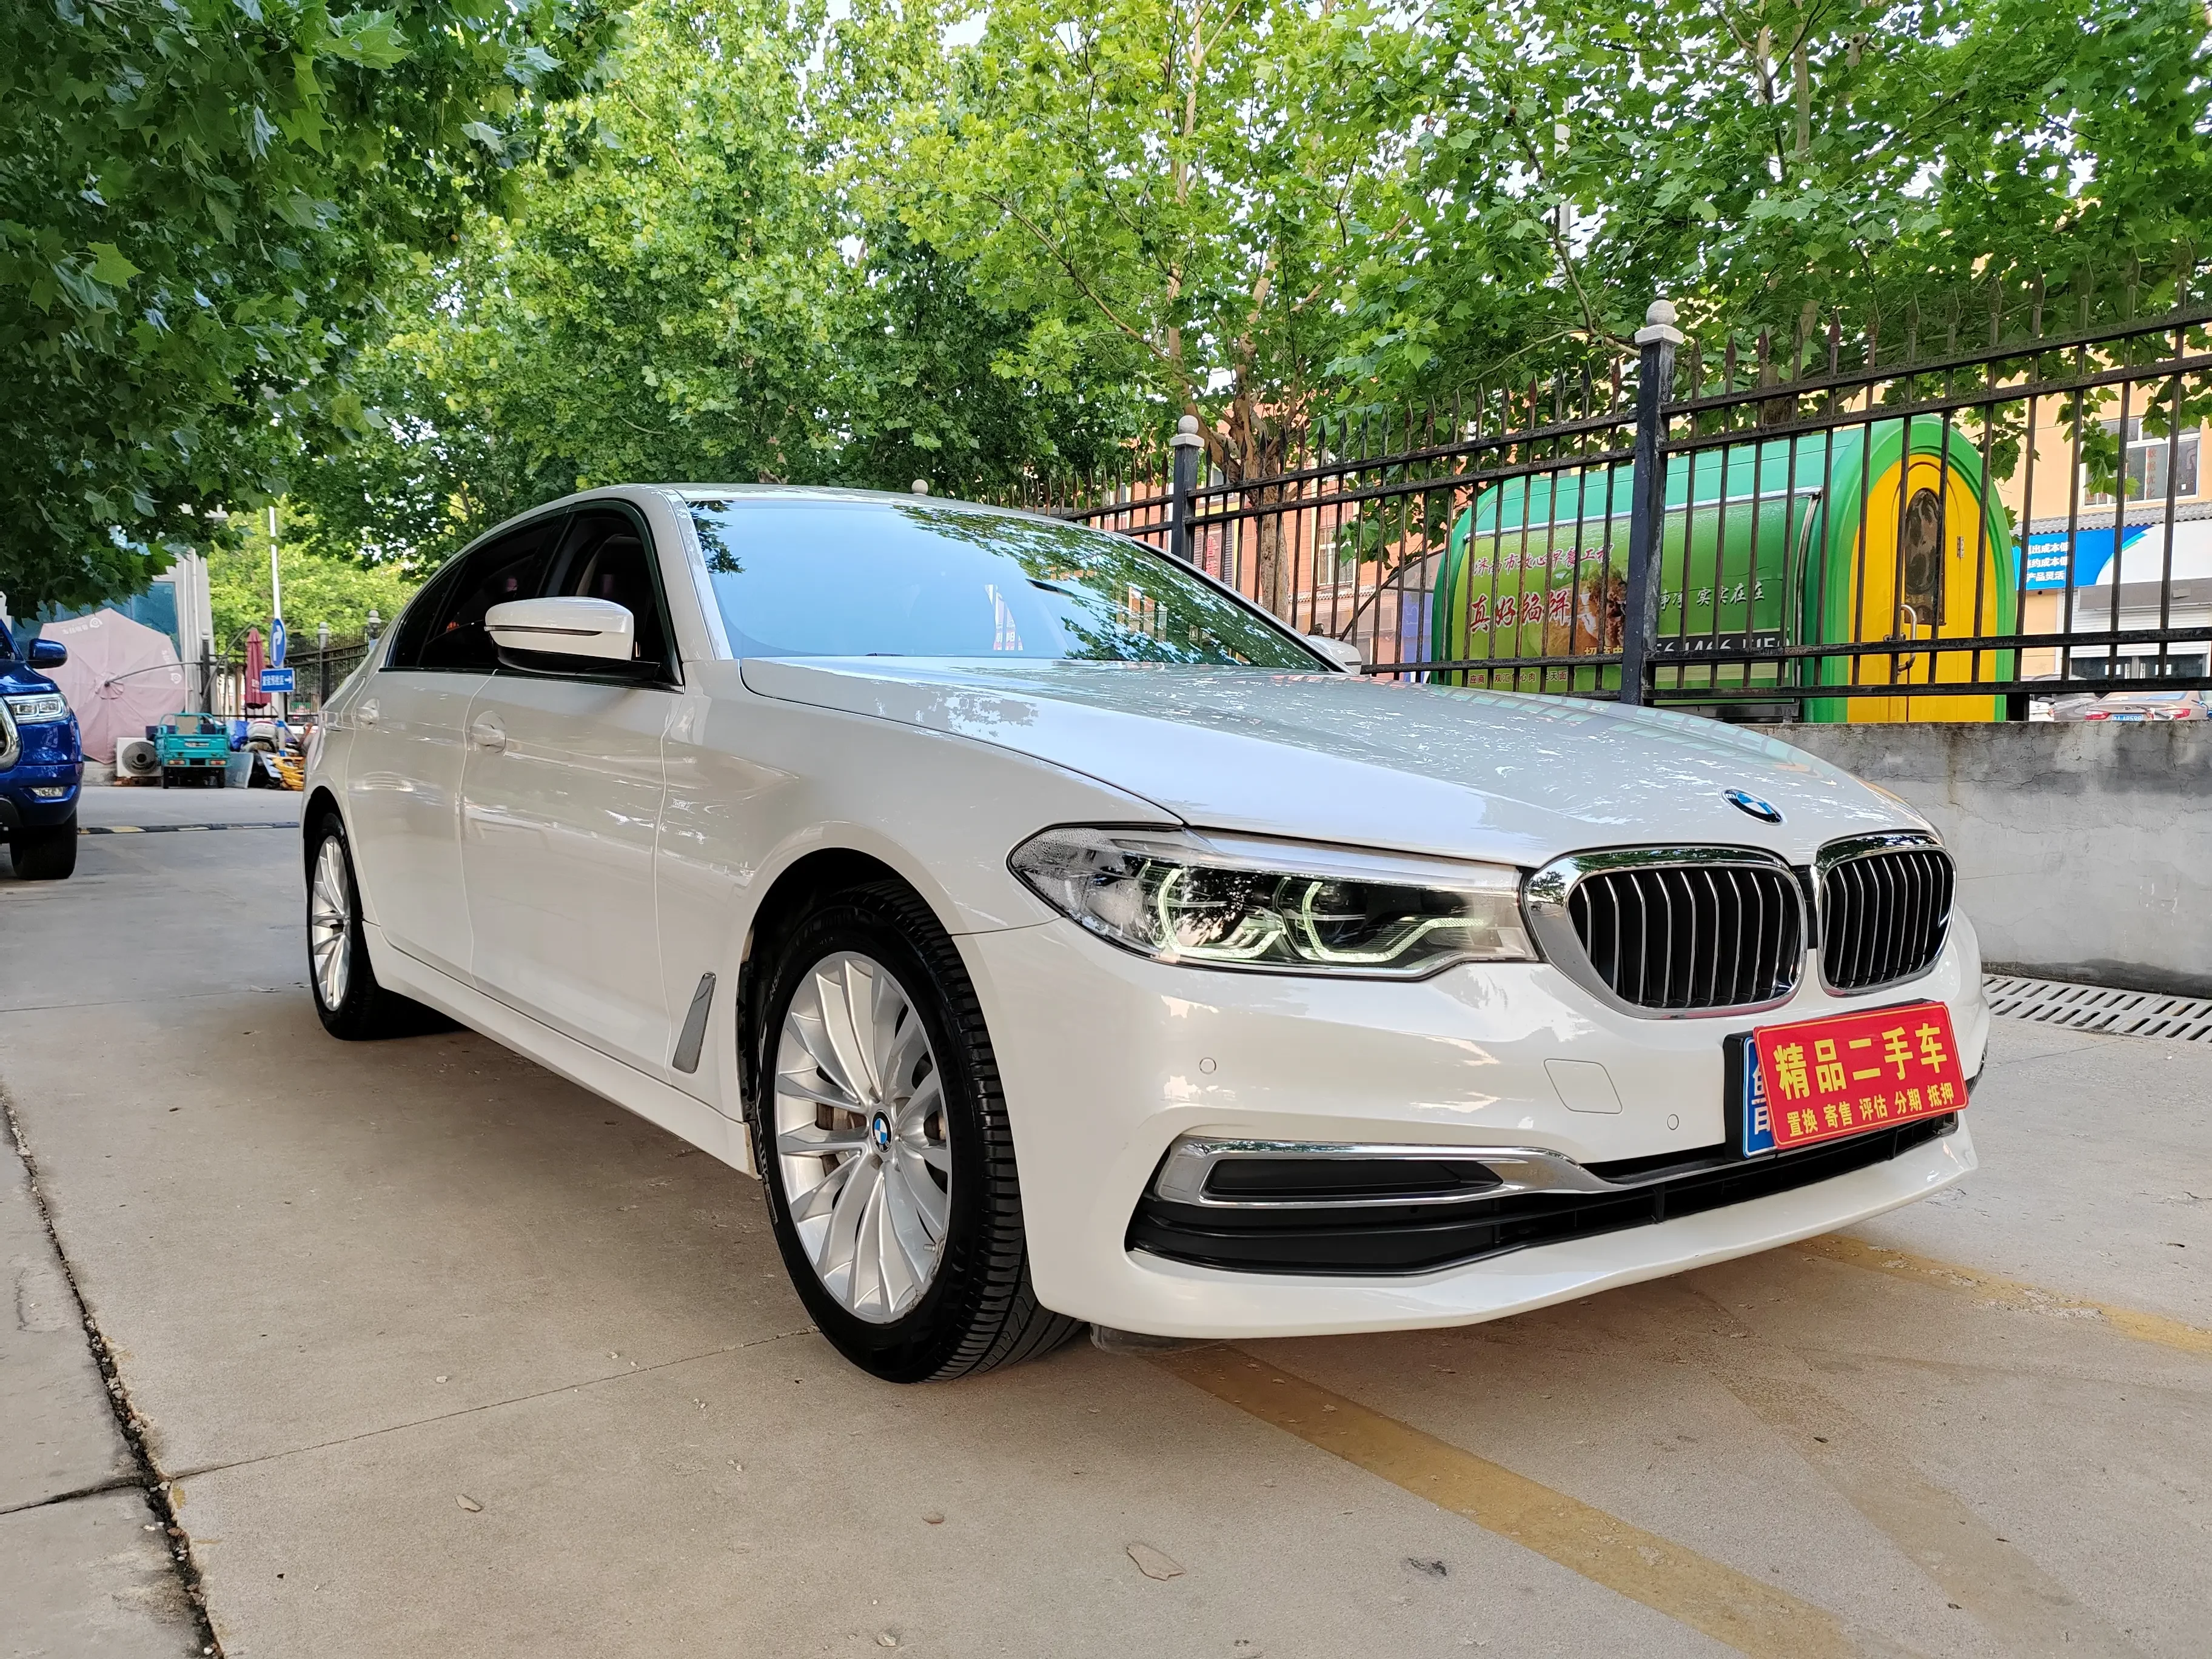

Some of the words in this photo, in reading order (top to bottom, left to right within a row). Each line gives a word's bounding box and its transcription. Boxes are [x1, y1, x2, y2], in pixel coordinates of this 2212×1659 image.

[2026, 571, 2065, 582] 产品灵活
[1467, 674, 1486, 685] 应商
[1773, 1023, 1948, 1100] 精品二手车
[1787, 1107, 1817, 1137] 置换
[1824, 1101, 1853, 1128] 寄售
[1859, 1094, 1888, 1122] 评估
[1894, 1088, 1922, 1115] 分期
[1927, 1082, 1954, 1108] 抵押
